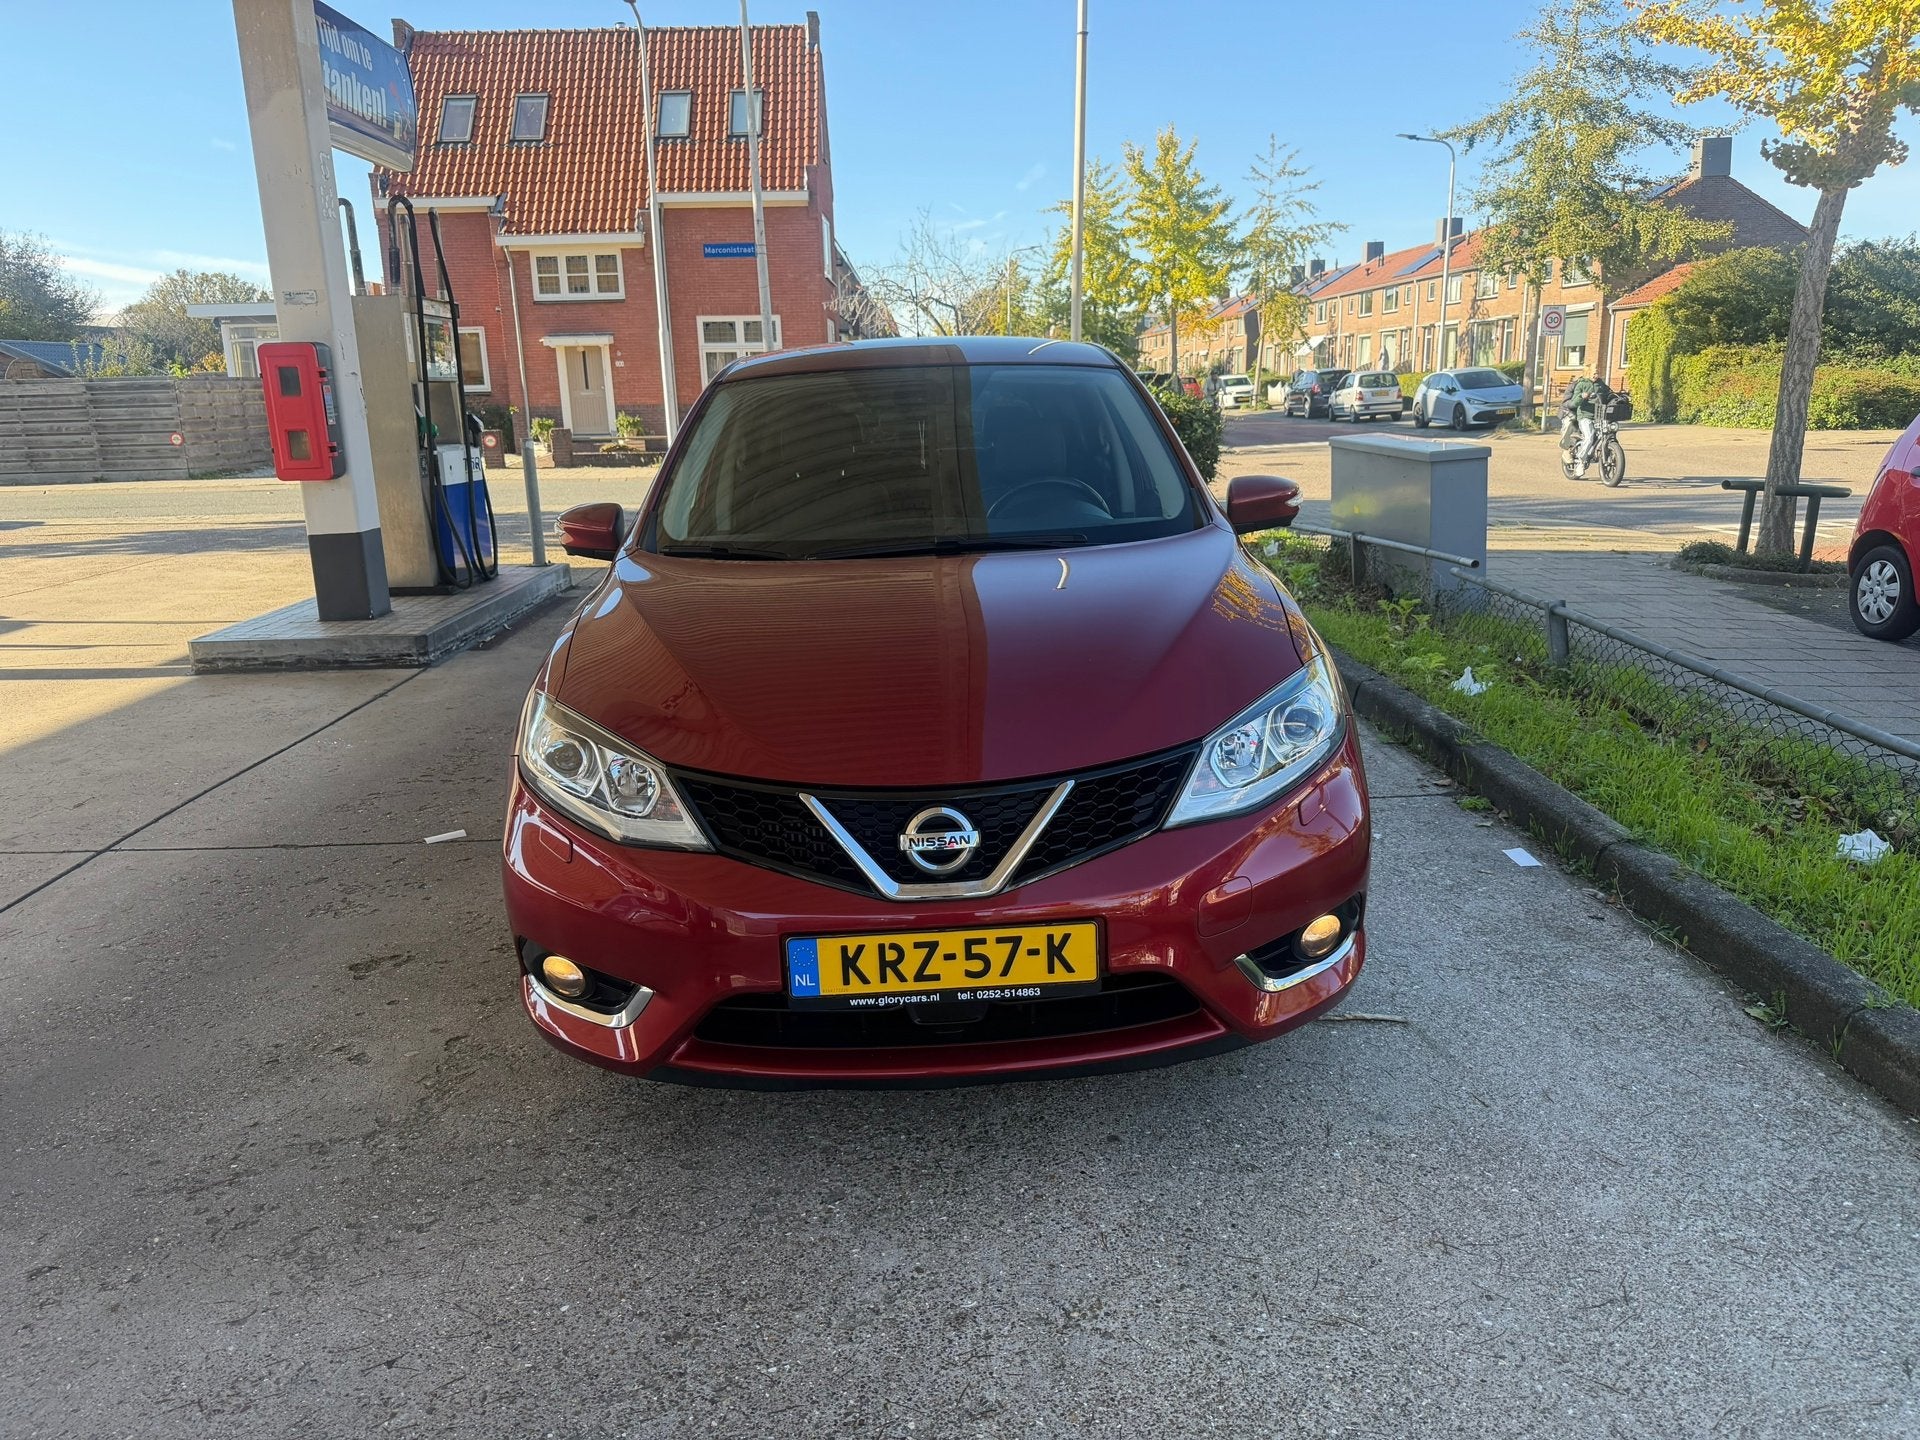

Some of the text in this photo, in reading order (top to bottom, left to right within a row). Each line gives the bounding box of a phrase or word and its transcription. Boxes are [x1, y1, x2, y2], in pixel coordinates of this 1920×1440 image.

[316, 15, 373, 71] Tijd om te
[323, 59, 387, 128] tanken!
[704, 246, 755, 255] Marconistraat
[1548, 316, 1559, 324] 30
[908, 834, 971, 848] NISSAN
[840, 933, 1076, 986] KRZ-57-K
[795, 974, 816, 987] NL
[849, 987, 1041, 1006] www.glorycars.nl tel: 0252-514863
